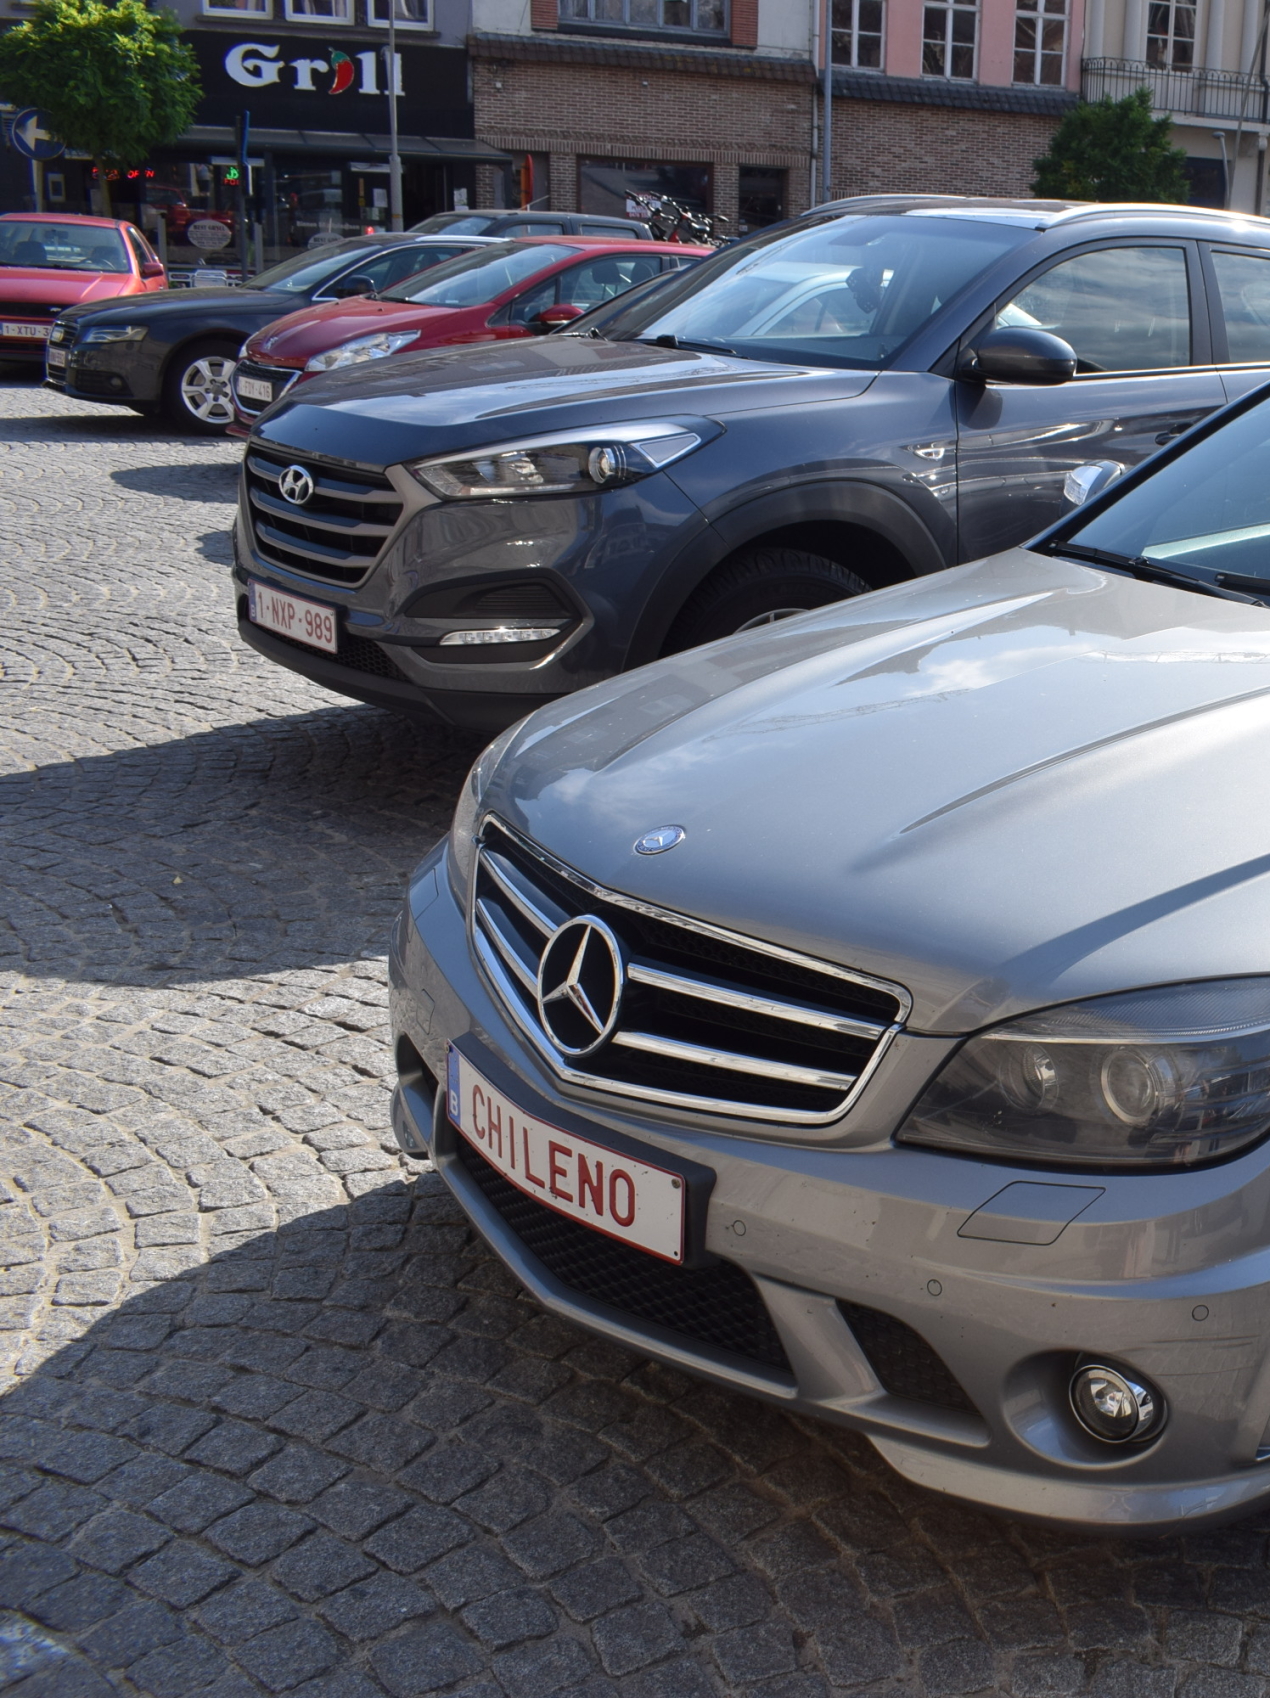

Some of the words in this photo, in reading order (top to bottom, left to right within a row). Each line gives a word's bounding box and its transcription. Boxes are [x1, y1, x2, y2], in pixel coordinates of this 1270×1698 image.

[5, 325, 50, 337] 1-XTU-3
[257, 591, 333, 644] 1-NXP-989
[450, 1089, 458, 1117] B
[472, 1084, 636, 1227] CHILENO
